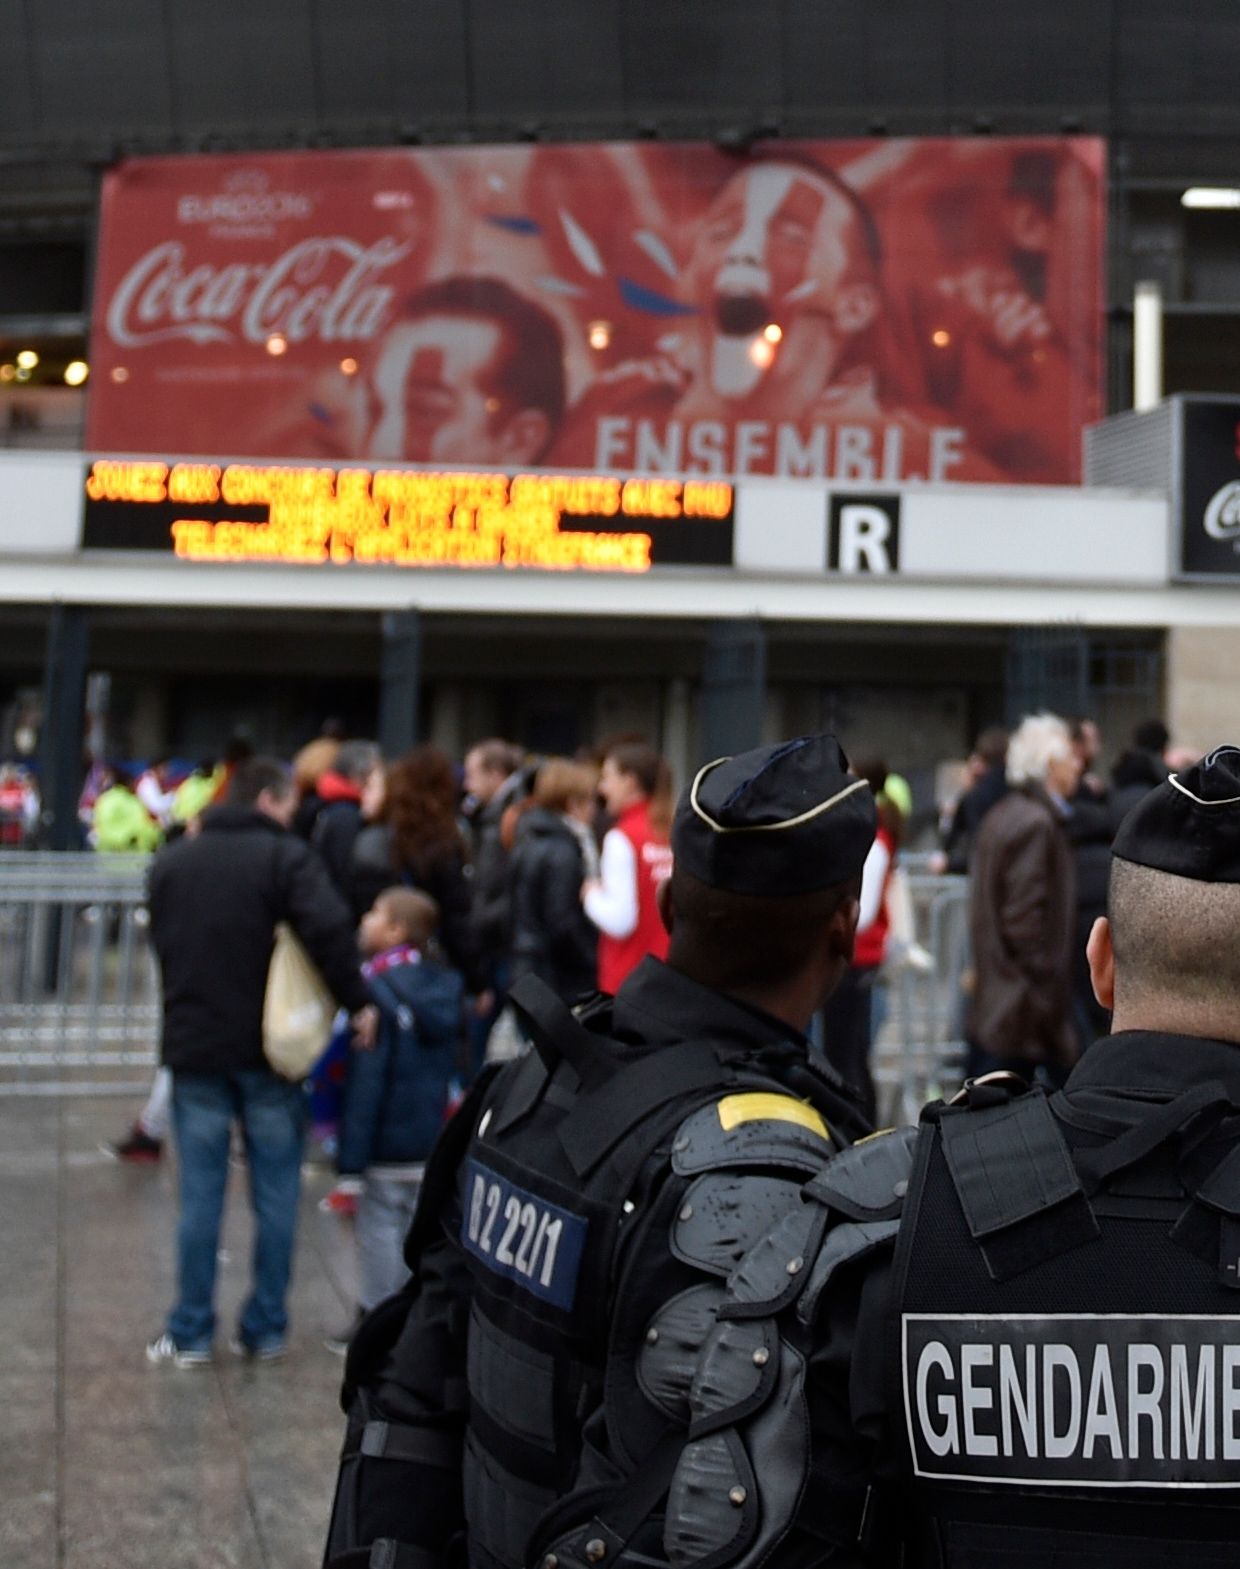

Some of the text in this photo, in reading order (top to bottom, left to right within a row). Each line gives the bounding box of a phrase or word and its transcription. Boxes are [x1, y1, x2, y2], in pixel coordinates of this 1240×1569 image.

[106, 238, 410, 349] Coca-Cola
[594, 415, 967, 484] ENSEMBLE
[86, 460, 168, 501] JOUEZ
[168, 463, 220, 503] AUX
[621, 478, 683, 517] AVEC
[838, 504, 894, 574] R
[495, 1195, 563, 1287] 22/1
